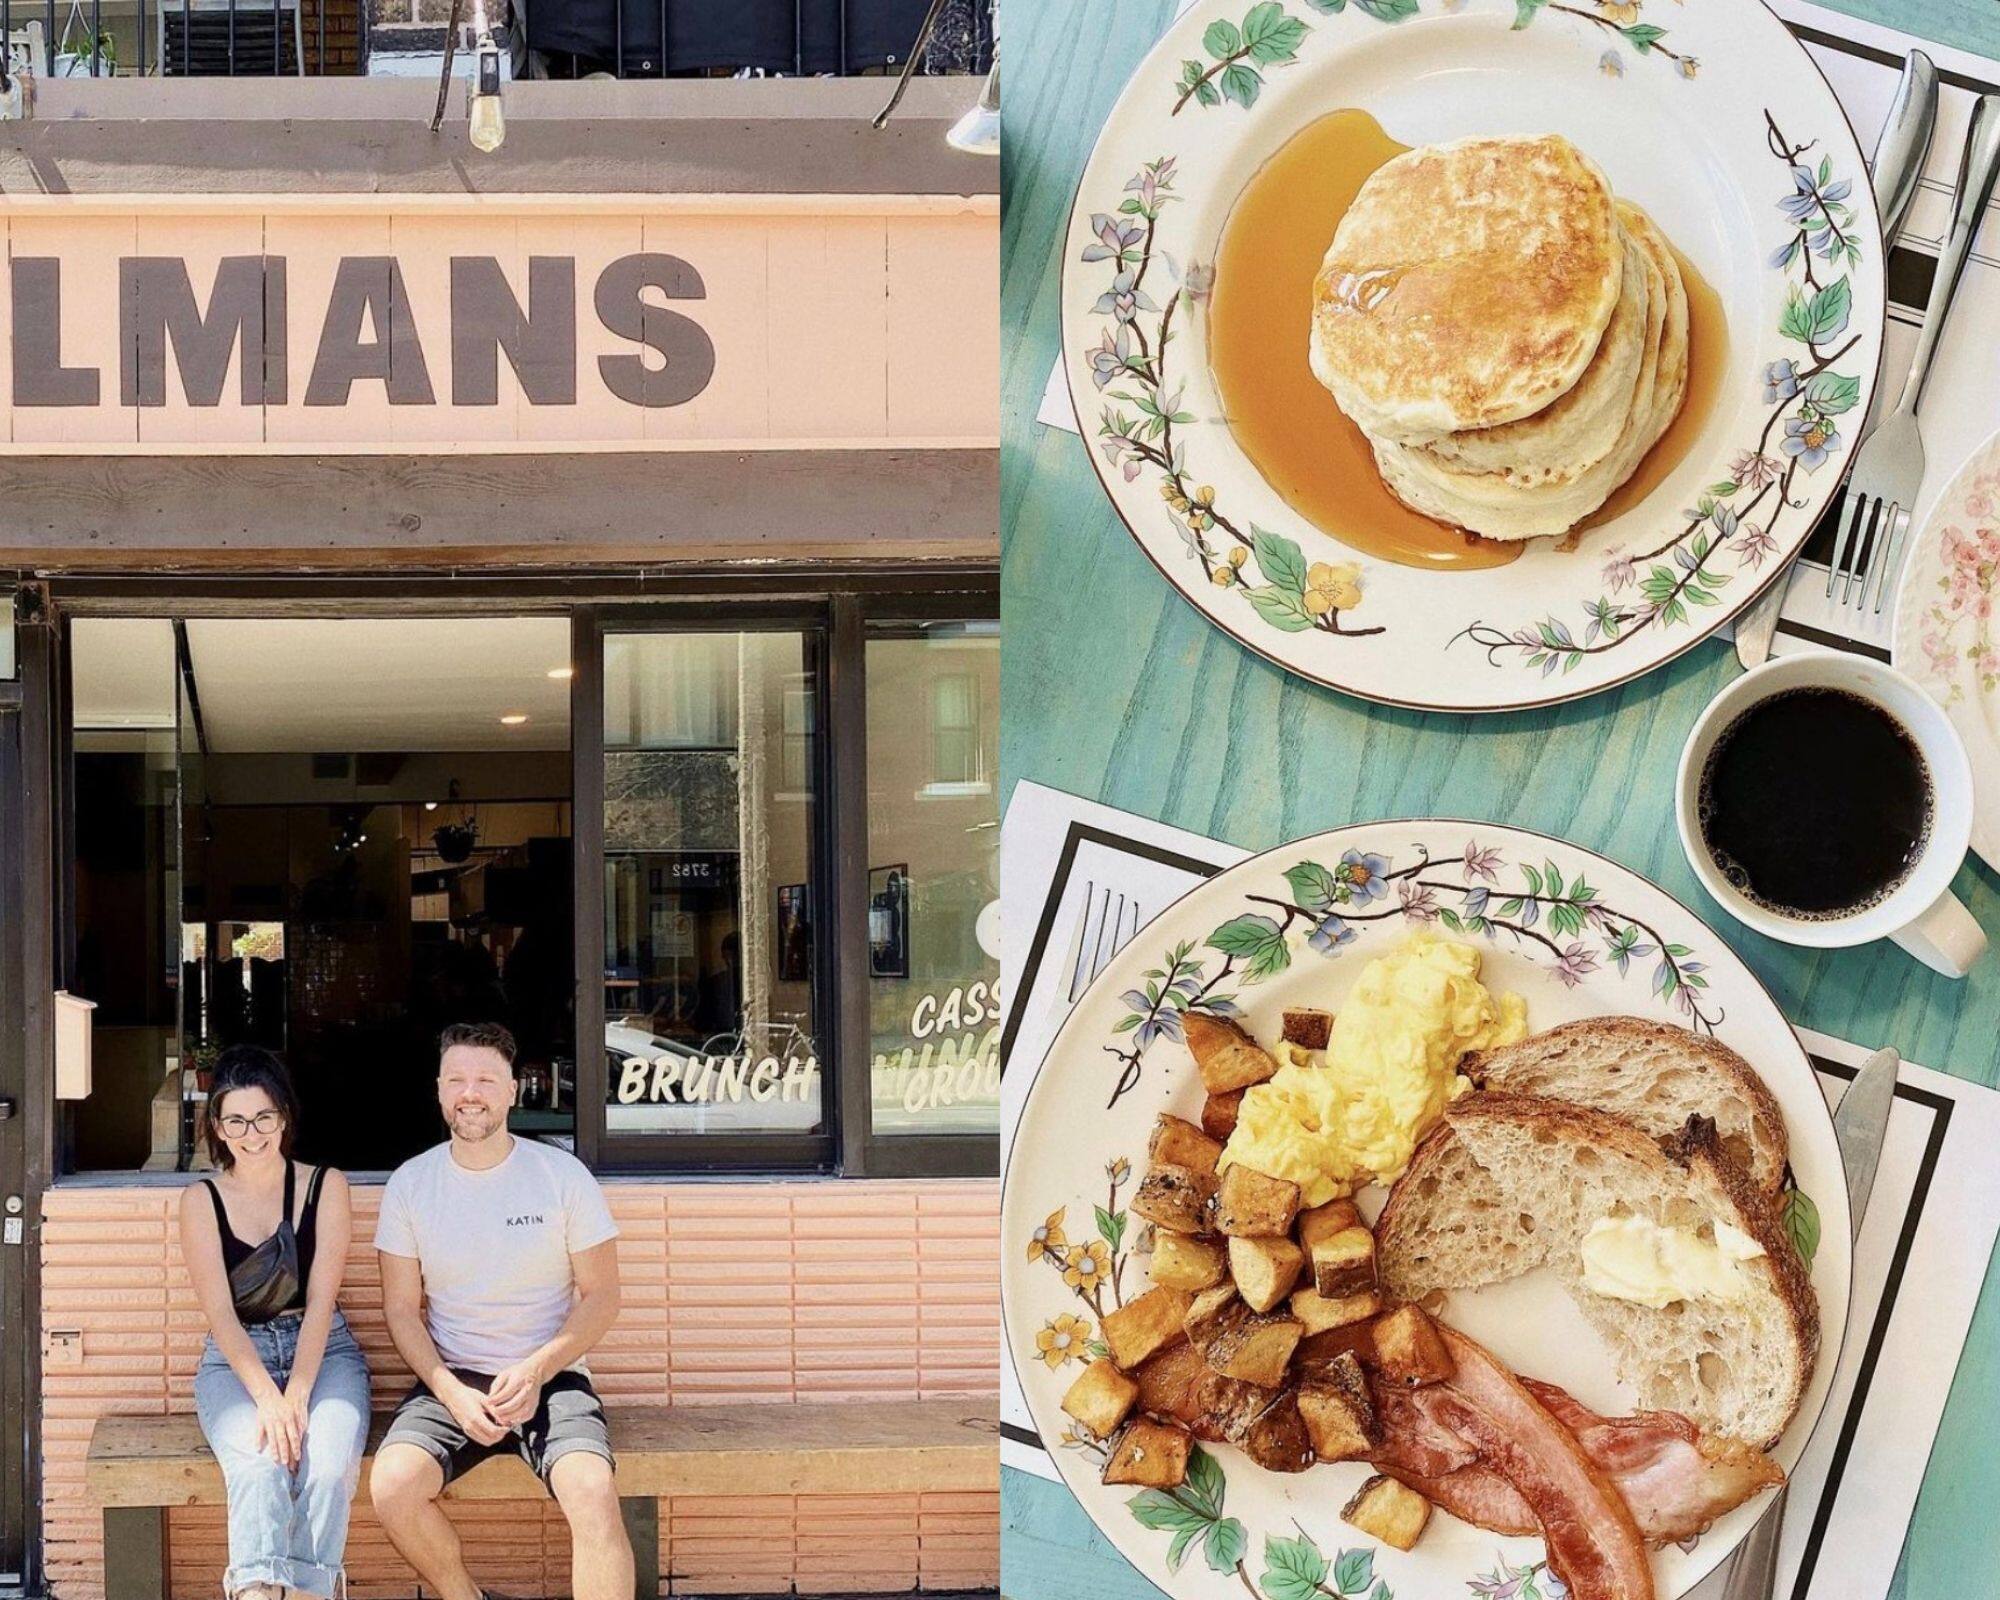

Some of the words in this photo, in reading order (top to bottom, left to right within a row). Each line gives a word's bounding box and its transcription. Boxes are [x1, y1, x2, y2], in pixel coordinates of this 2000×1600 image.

[11, 252, 716, 408] LMANS
[617, 1055, 817, 1104] BRUNCH
[506, 1214, 544, 1227] KATIN
